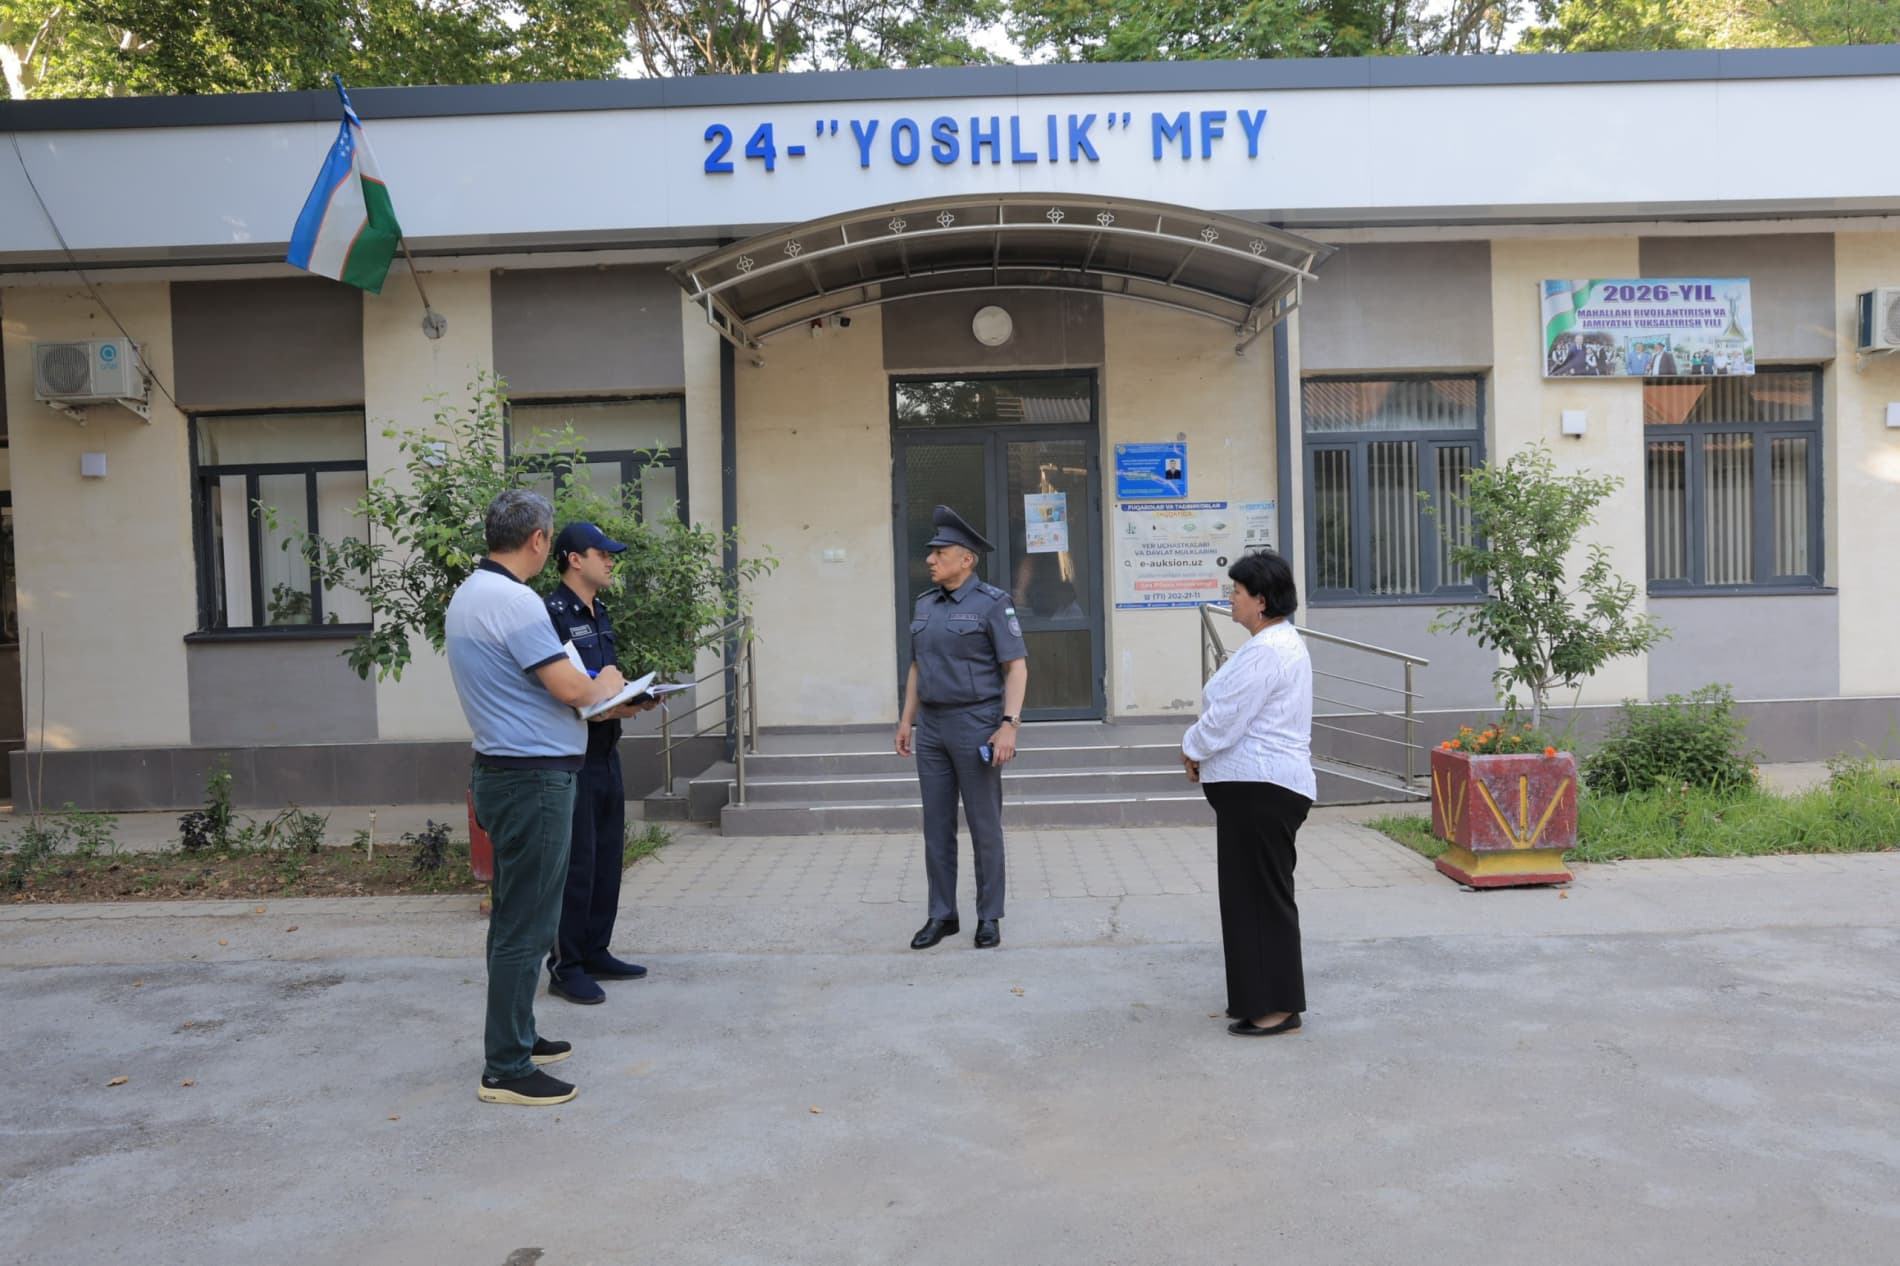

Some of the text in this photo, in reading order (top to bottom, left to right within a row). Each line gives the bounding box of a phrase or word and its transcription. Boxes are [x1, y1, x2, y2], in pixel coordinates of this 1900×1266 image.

[1152, 108, 1267, 161] MFY
[1603, 285, 1716, 302] 2026-YIL
[1577, 308, 1726, 318] MAHALLANI RIVOJLANTIRISH VA
[1635, 319, 1700, 328] YUKSALTIRISH
[1704, 318, 1722, 327] YILI
[1140, 559, 1203, 567] e-auksion.uz
